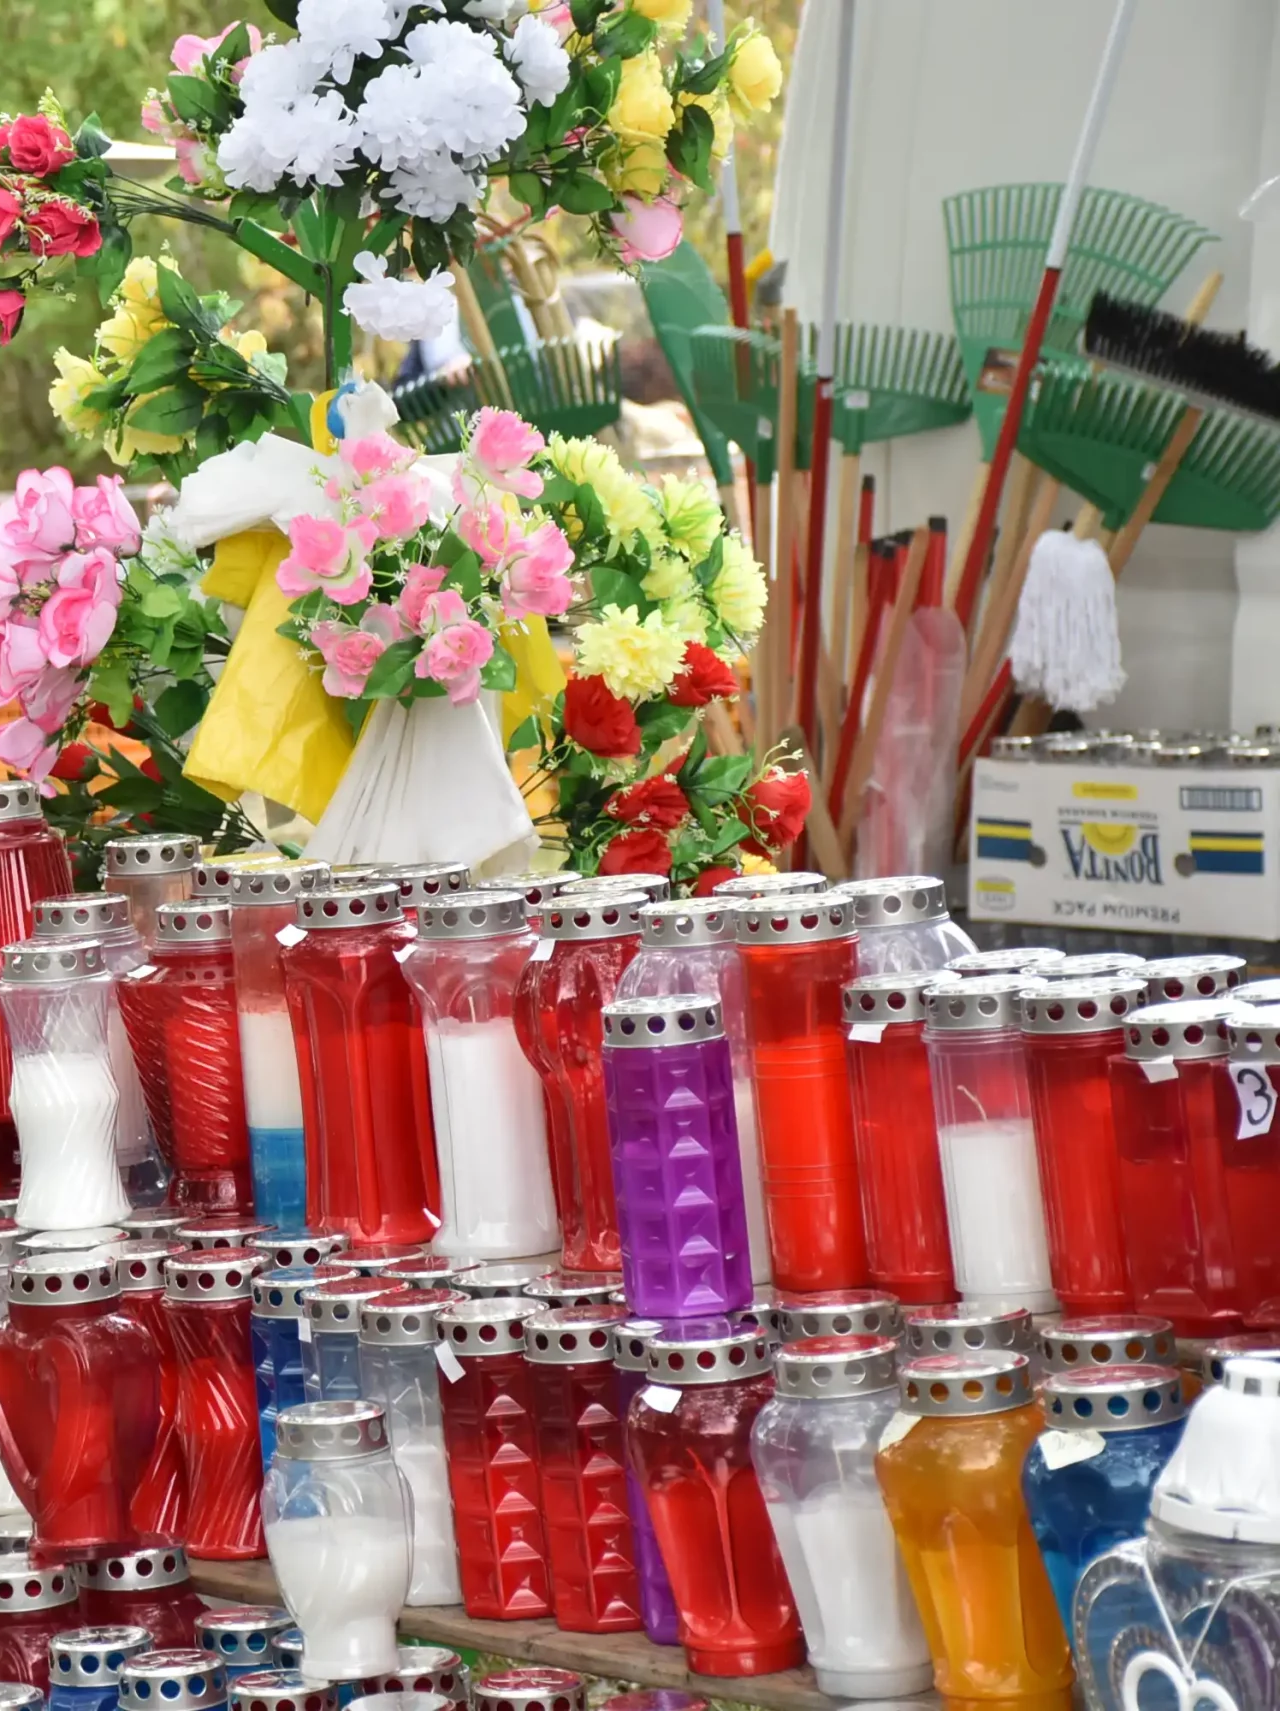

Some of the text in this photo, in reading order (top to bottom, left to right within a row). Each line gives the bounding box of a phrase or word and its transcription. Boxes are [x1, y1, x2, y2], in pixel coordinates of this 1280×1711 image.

[1060, 828, 1164, 885] BONITA
[1054, 900, 1181, 924] PREMIUM PACK
[1237, 1068, 1273, 1126] 3
